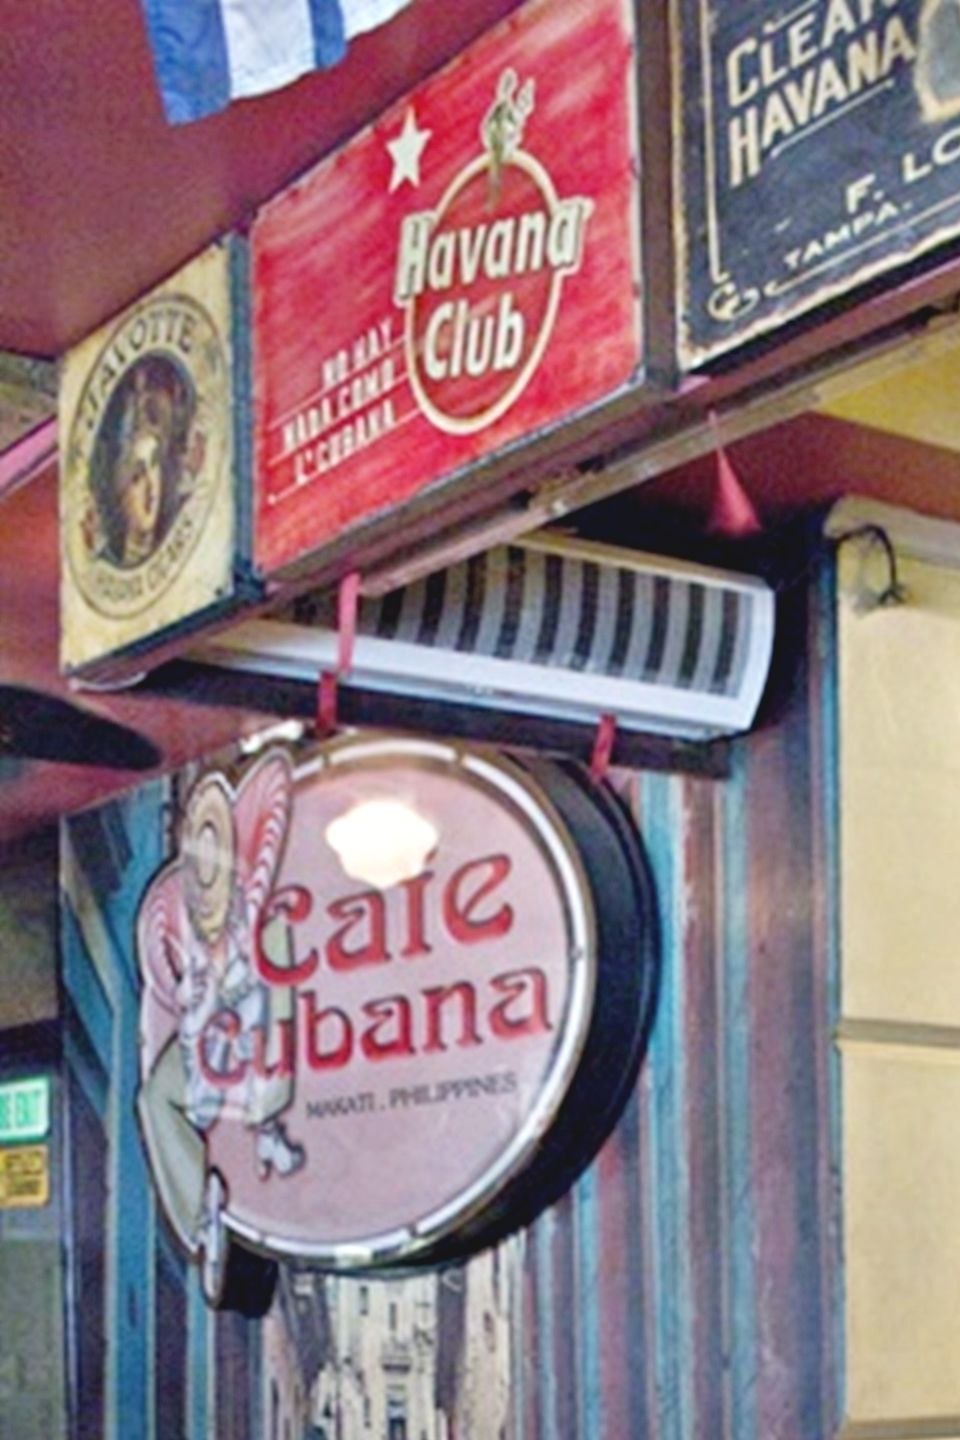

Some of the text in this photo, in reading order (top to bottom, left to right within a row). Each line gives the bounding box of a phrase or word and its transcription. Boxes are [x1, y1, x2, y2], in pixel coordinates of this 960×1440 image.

[729, 15, 917, 188] HAVANA
[846, 172, 885, 214] F.
[396, 199, 590, 302] Havana
[322, 316, 394, 391] NO HAY
[423, 291, 525, 381] Club
[283, 356, 395, 456] NADA COMO
[389, 1070, 518, 1109] PHILIPPINES
